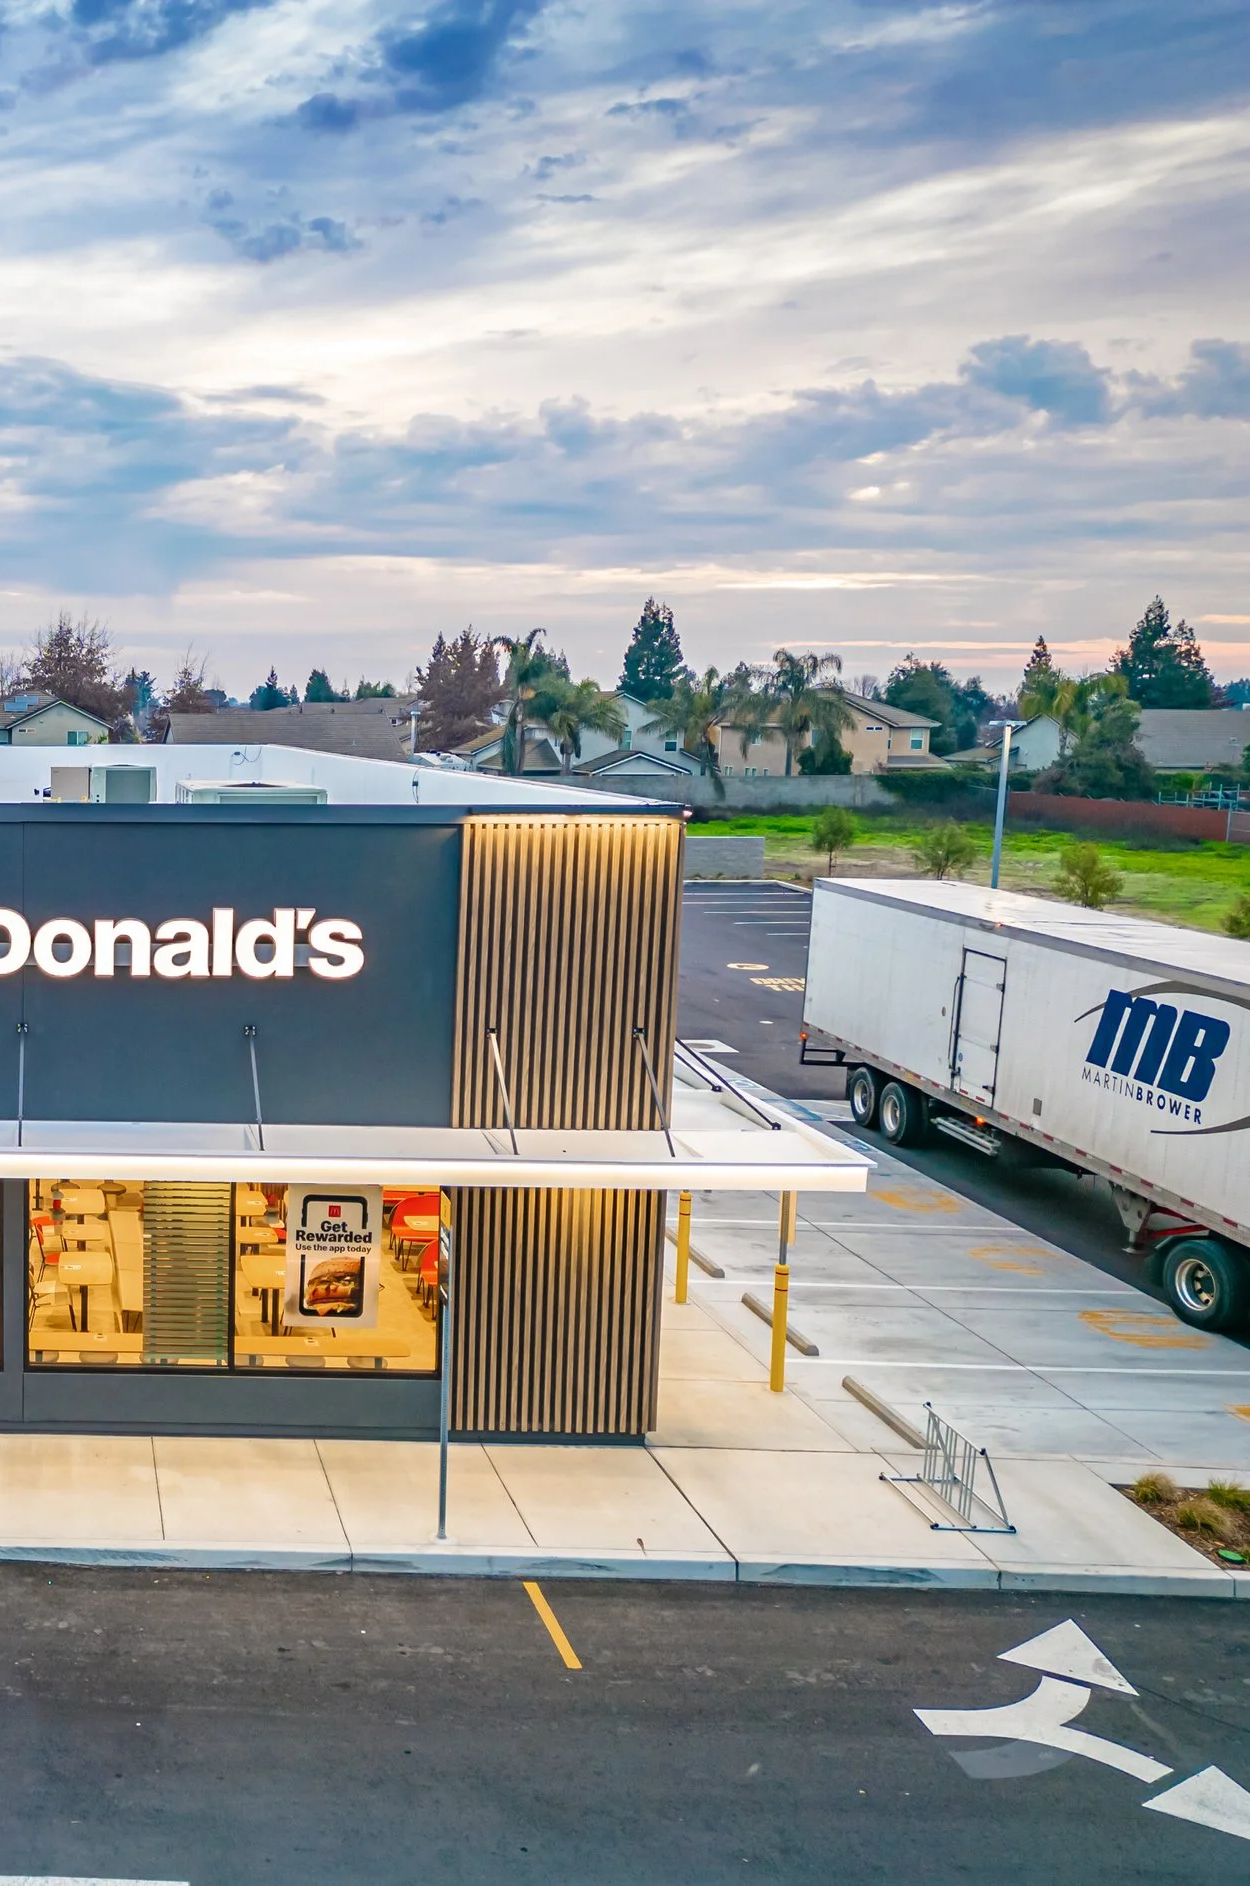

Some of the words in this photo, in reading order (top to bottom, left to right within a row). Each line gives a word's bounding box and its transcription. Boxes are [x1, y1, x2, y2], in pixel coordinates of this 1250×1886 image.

[1085, 989, 1231, 1103] MB
[320, 1220, 348, 1233] Get
[295, 1229, 372, 1244] Rewarded
[295, 1243, 312, 1251] Use
[329, 1245, 346, 1253] app
[347, 1245, 372, 1255] today
